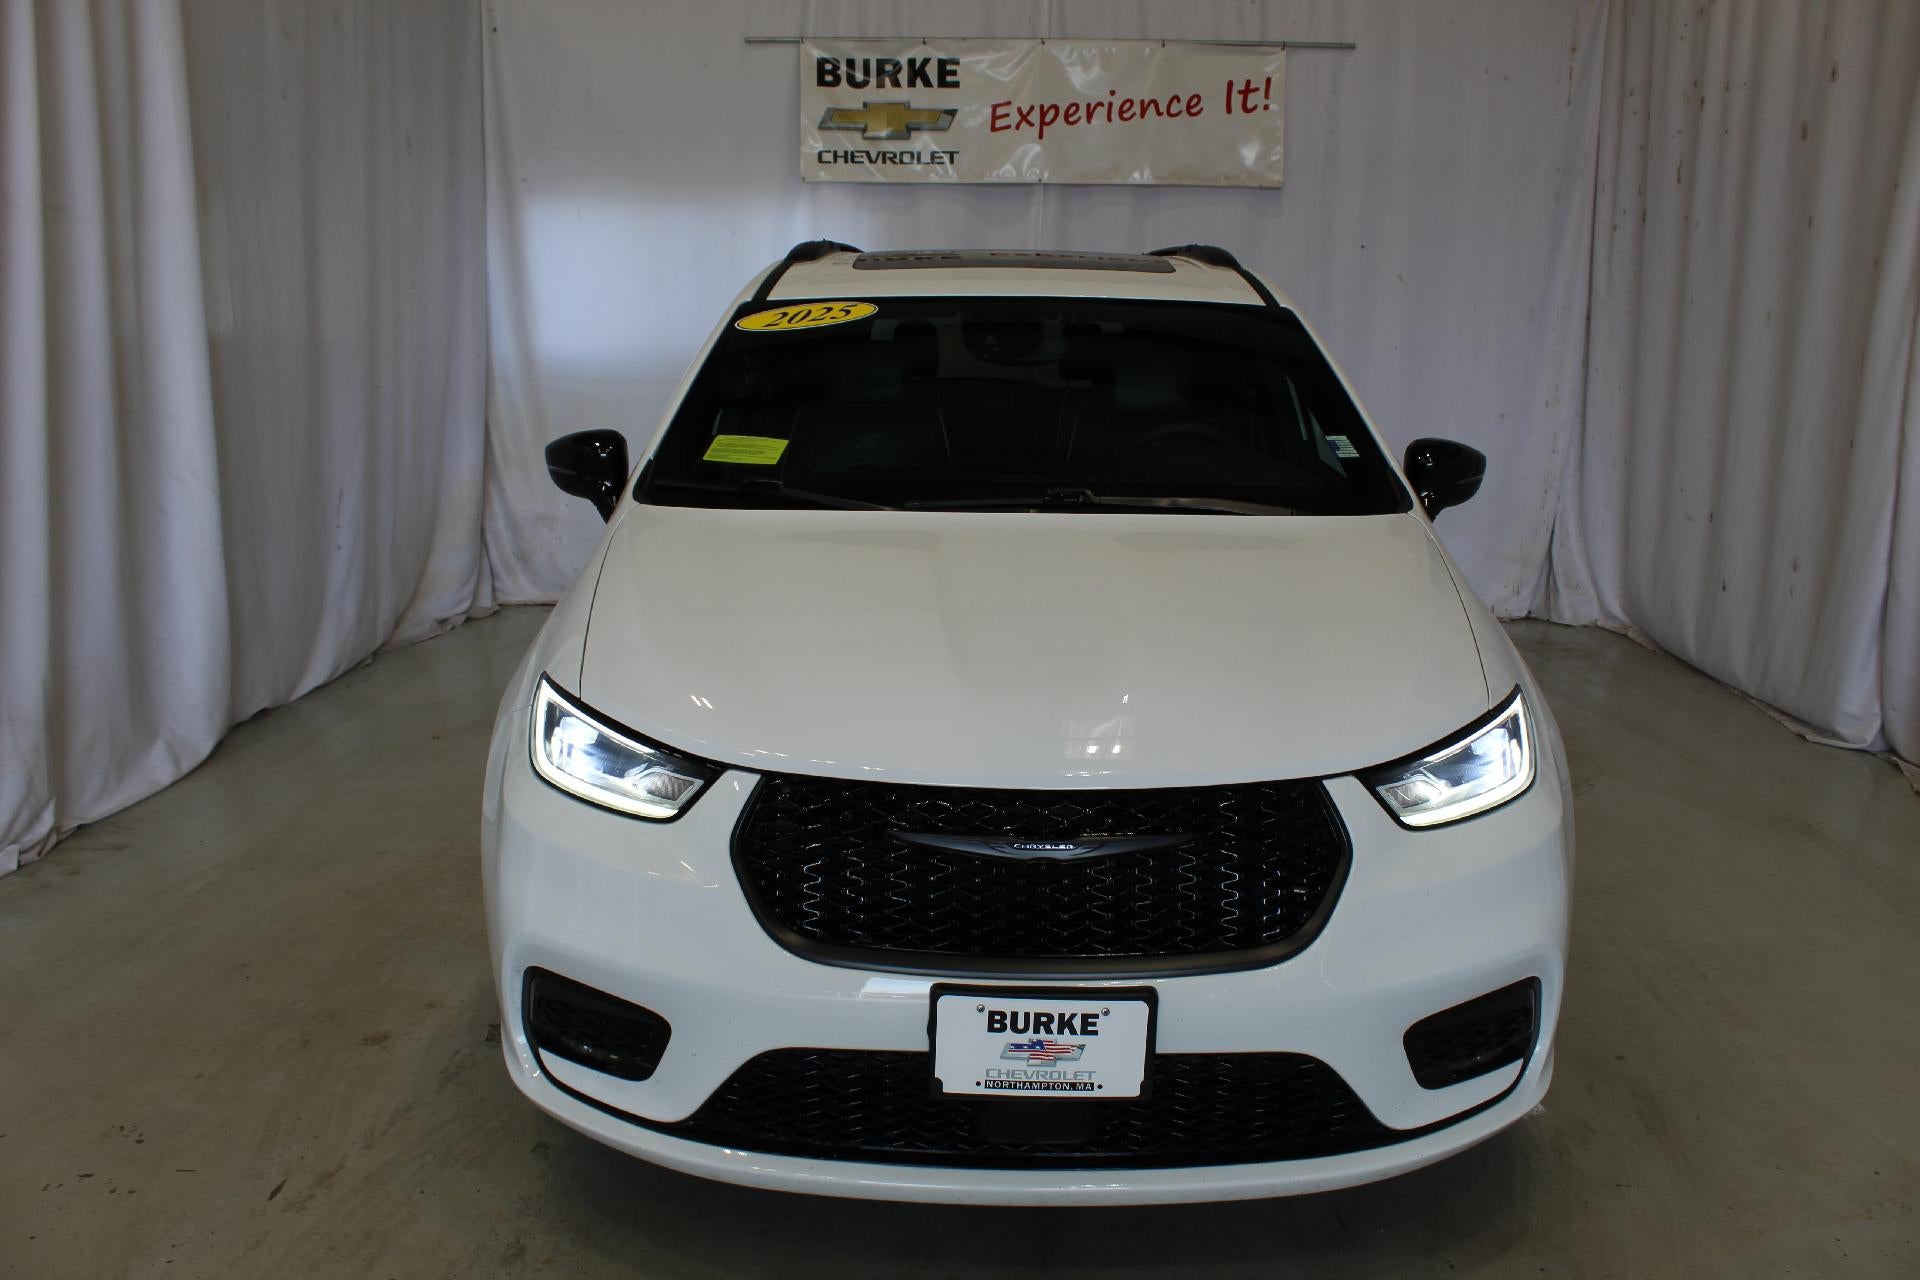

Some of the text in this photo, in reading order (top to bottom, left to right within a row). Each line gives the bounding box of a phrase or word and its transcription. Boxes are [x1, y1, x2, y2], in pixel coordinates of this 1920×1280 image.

[816, 57, 960, 89] BURKE
[990, 76, 1272, 140] Experience It!
[817, 149, 960, 165] CHEVROLET
[762, 304, 858, 328] 2025
[986, 1010, 1100, 1036] BURKE
[985, 1068, 1096, 1081] CHEVROLET
[1075, 1082, 1092, 1091] MA
